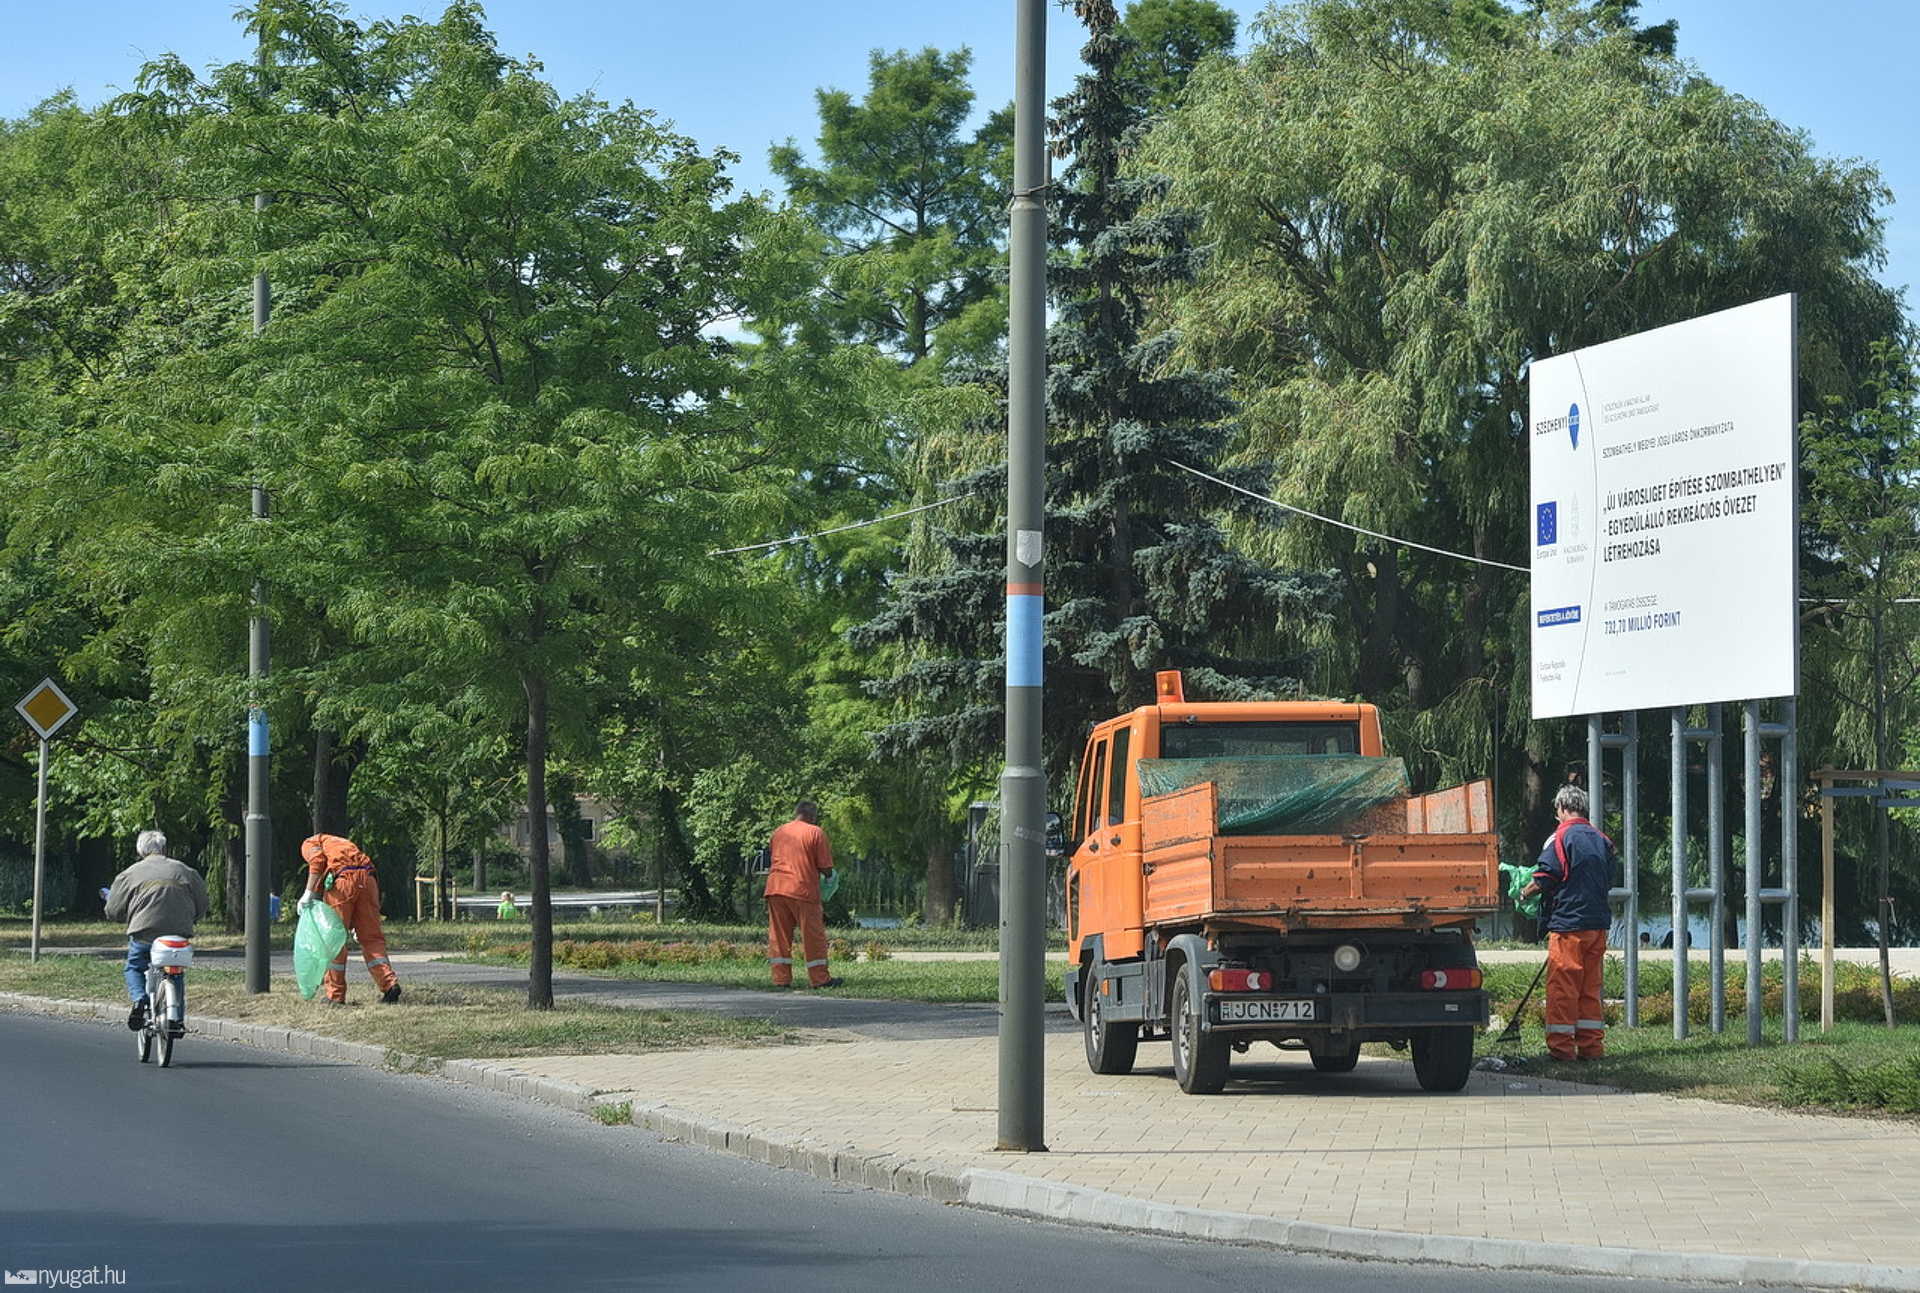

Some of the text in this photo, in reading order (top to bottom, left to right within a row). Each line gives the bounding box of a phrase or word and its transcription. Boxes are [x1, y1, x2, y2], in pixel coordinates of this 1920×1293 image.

[1617, 484, 1667, 508] VÁROSLIGET
[1668, 475, 1703, 499] ÉPÍTÉSE
[1666, 498, 1721, 526] REKREÁCIÓS
[1603, 535, 1661, 563] LÉTREHOZÁSA
[1627, 611, 1652, 632] MILLIÓ
[1653, 610, 1681, 630] FORINT
